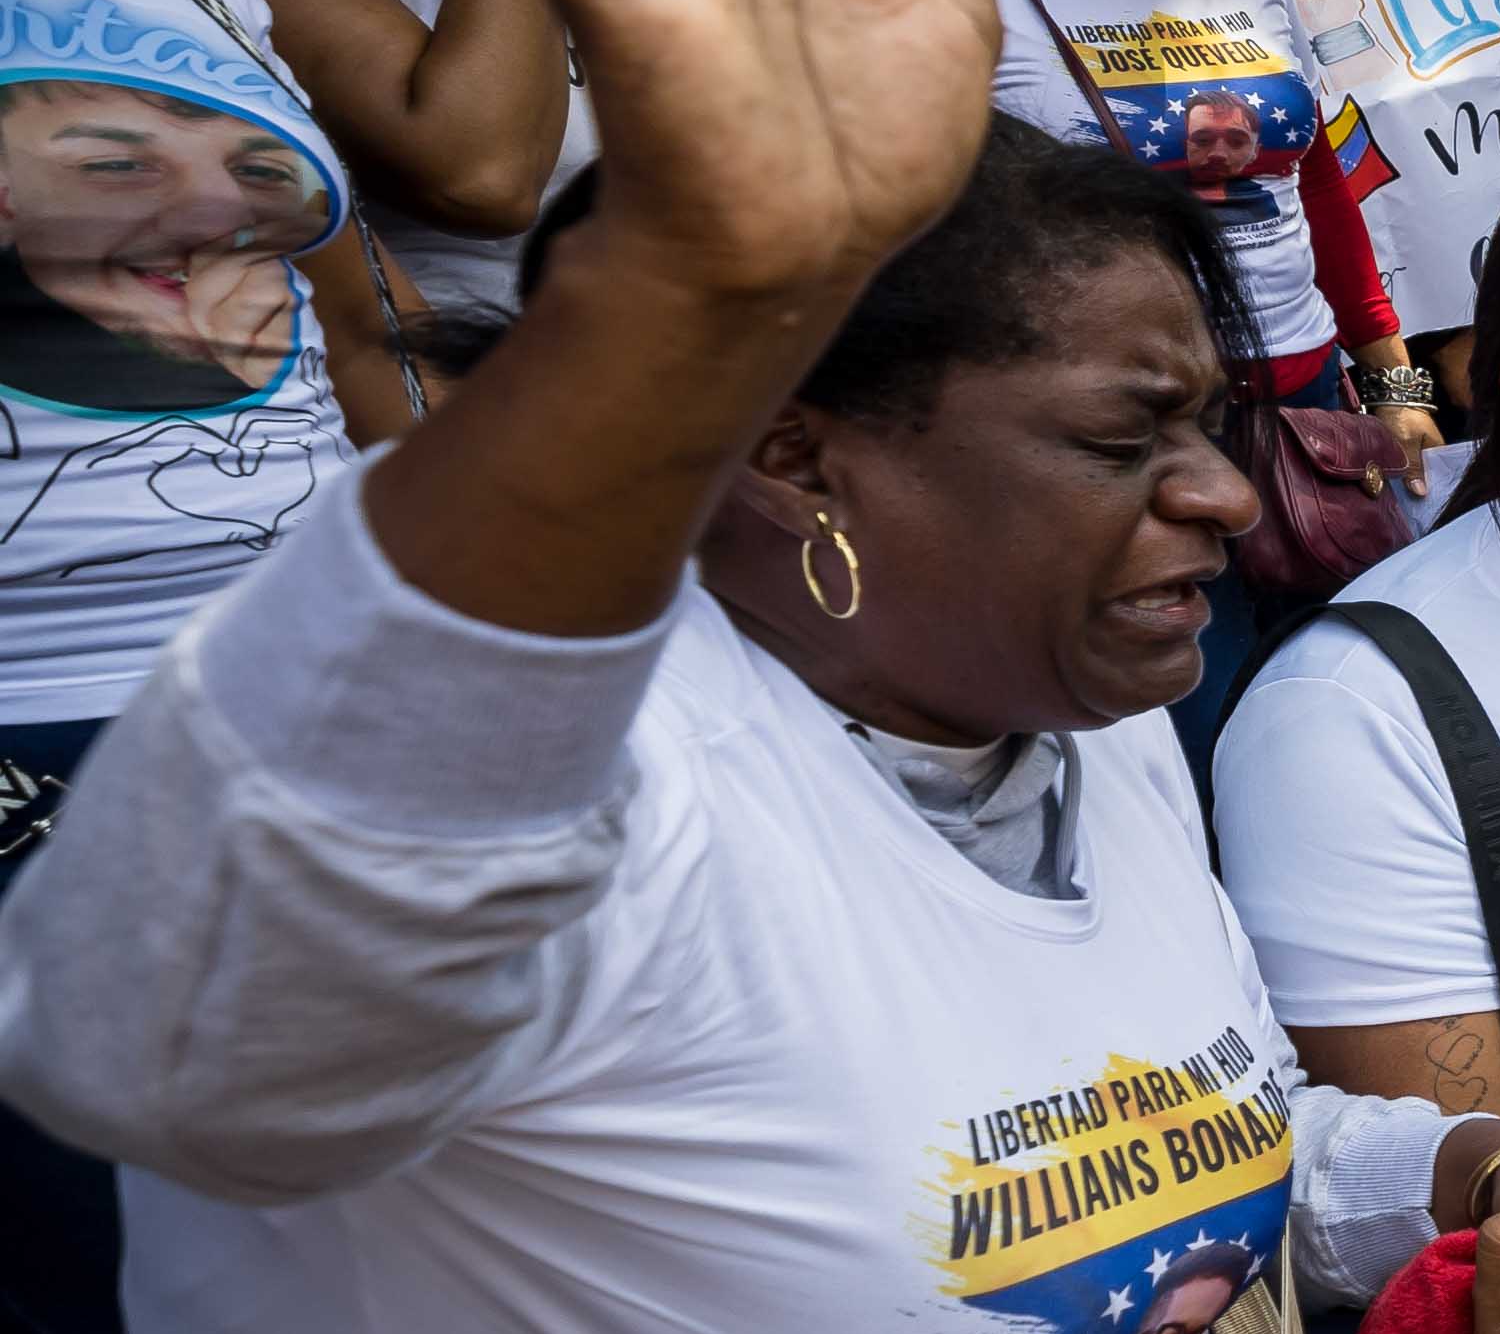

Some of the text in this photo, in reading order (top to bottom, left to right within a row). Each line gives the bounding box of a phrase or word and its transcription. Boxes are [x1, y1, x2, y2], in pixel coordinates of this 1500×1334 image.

[1065, 10, 1255, 44] LIBERTAD PARA MI HIJO
[1097, 38, 1269, 74] JOSÉ QUEVEDO
[968, 1026, 1255, 1167] LIBERTAD PARA MI HIJO
[951, 1138, 1159, 1260] WILLIANS
